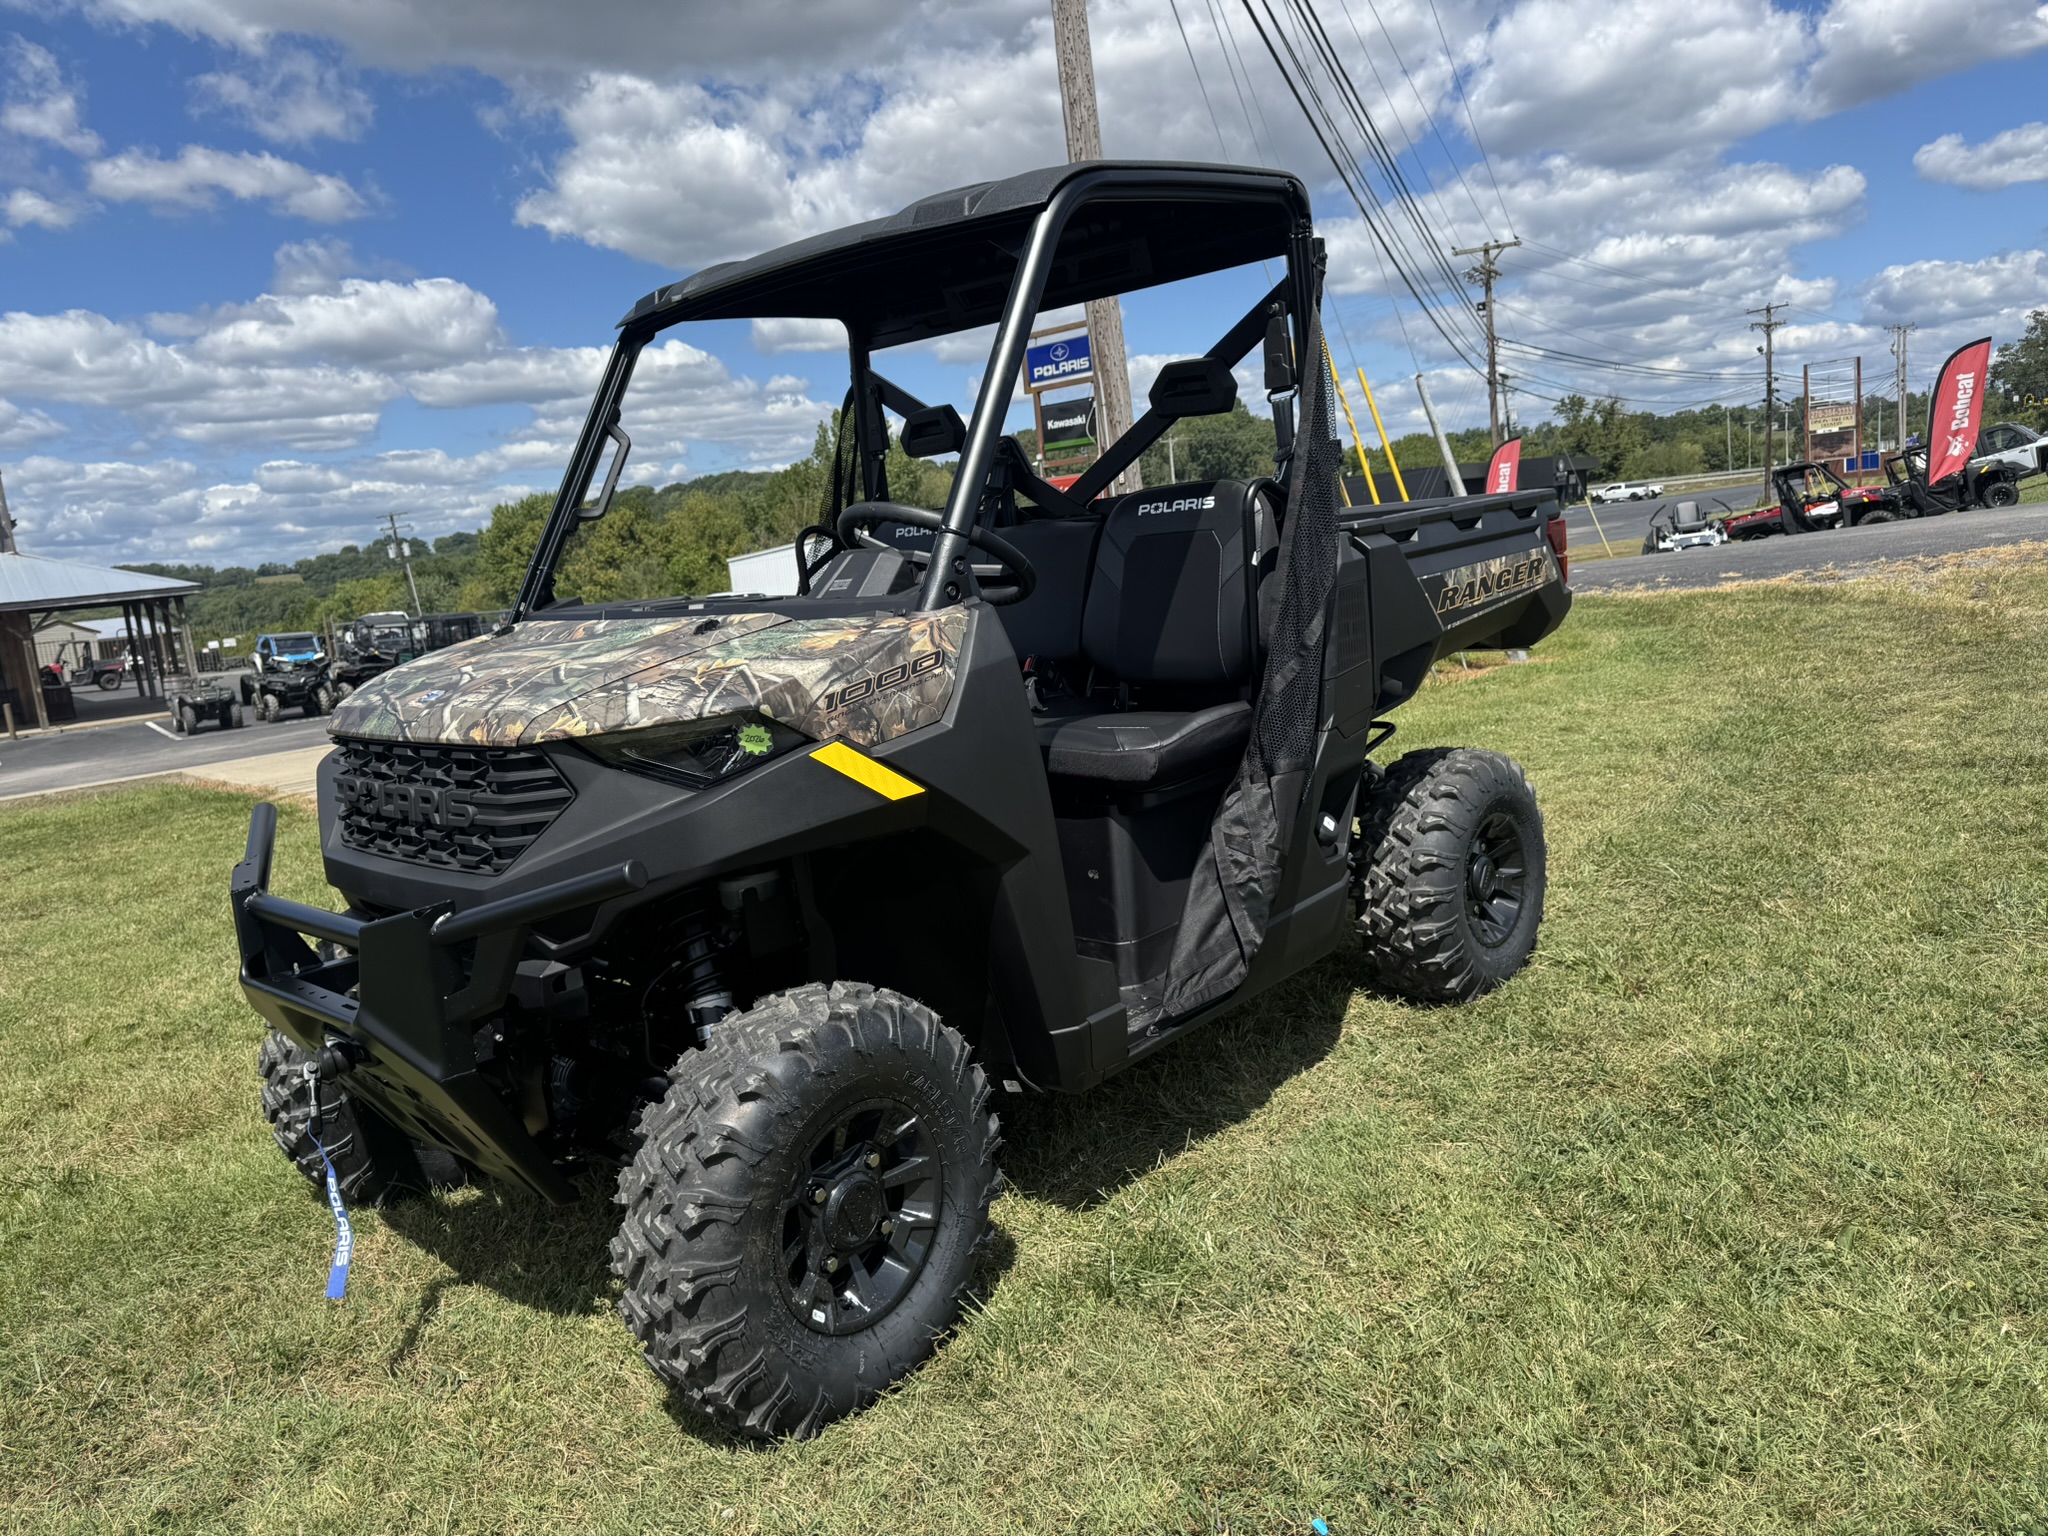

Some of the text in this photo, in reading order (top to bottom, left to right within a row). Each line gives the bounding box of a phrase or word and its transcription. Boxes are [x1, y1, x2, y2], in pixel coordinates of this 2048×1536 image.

[1033, 357, 1090, 379] POLARIS
[1047, 414, 1086, 430] Kawasaki
[1951, 371, 1975, 429] Bobcat
[1496, 462, 1511, 493] bcat
[1138, 496, 1216, 516] POLARIS
[1436, 556, 1544, 614] RANGER
[823, 647, 945, 714] 1000
[342, 776, 477, 828] POLARIS
[326, 1177, 351, 1267] POLARIS
